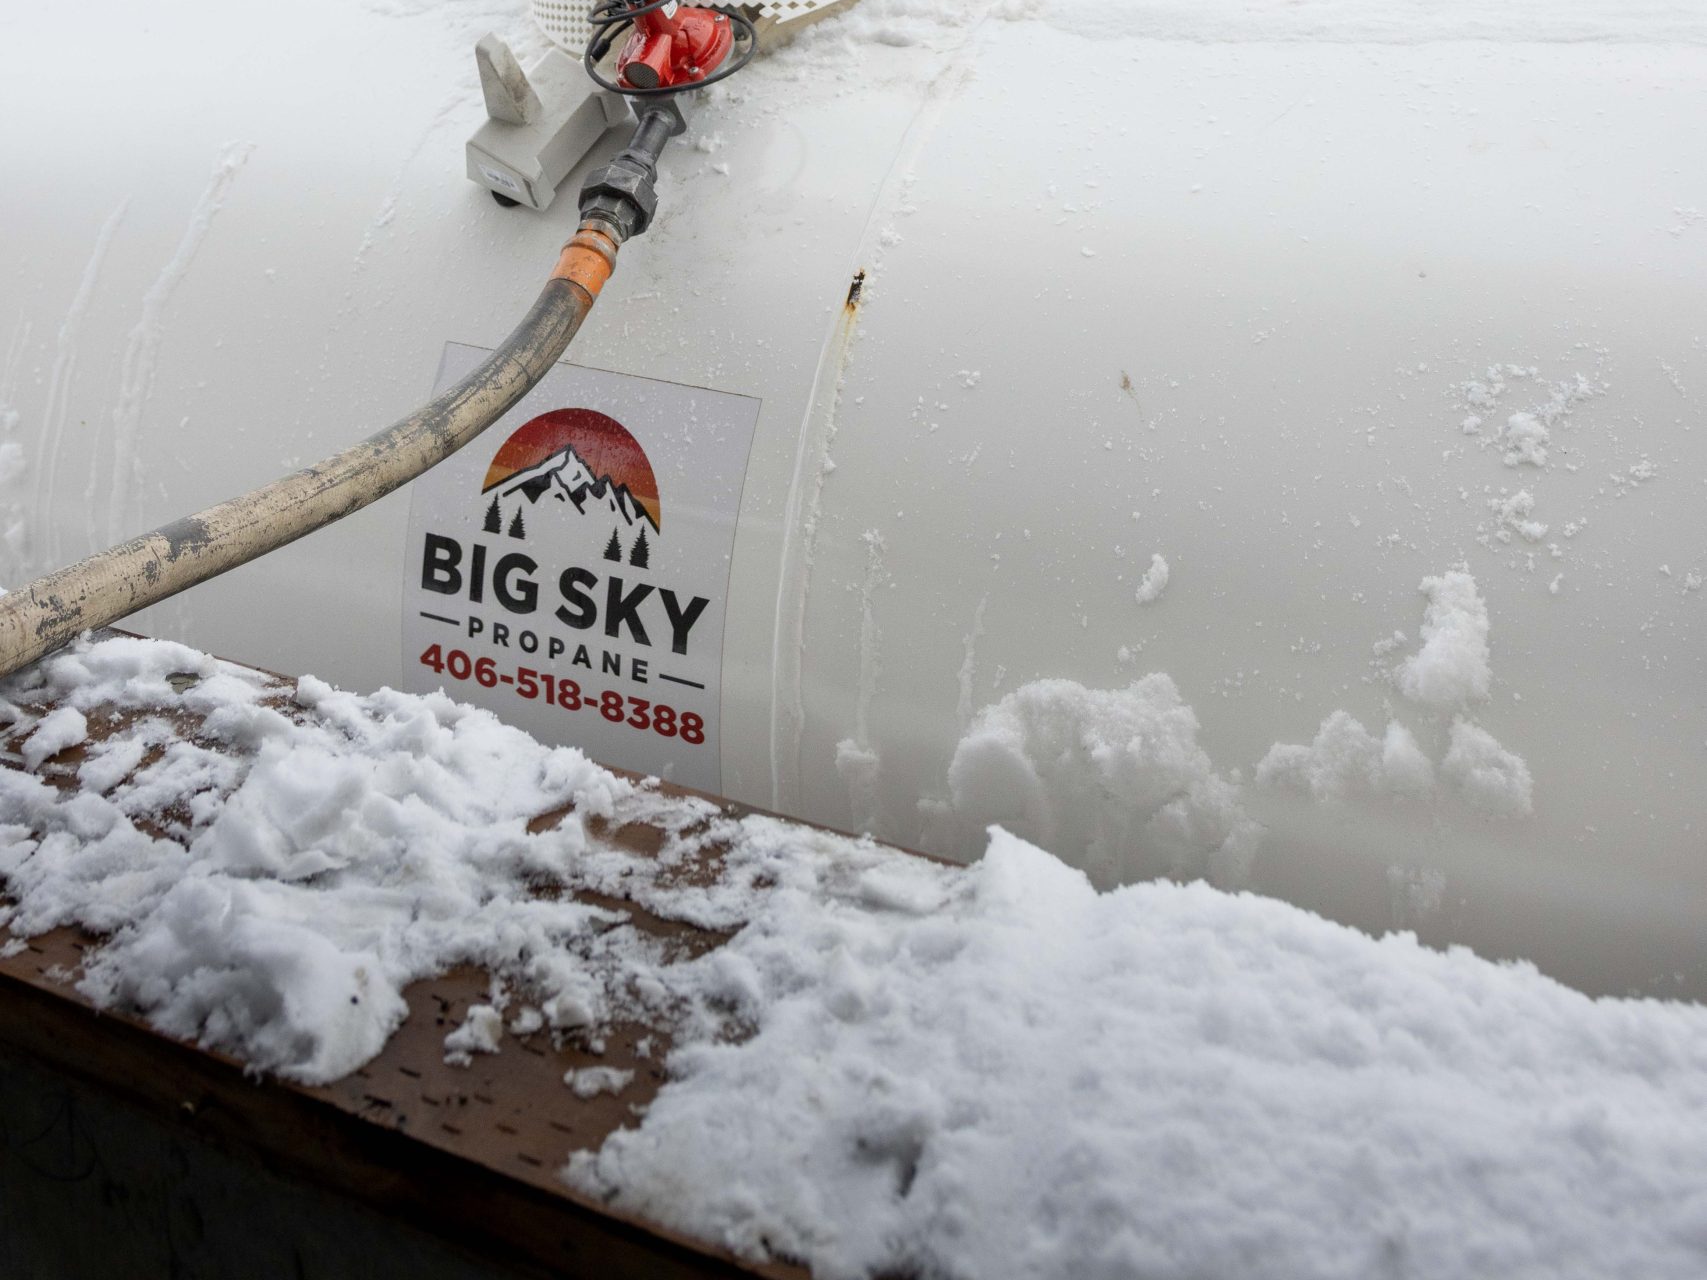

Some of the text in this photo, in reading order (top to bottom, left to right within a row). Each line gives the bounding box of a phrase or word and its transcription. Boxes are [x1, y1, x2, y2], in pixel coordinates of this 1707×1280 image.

[421, 533, 710, 655] BIG SKY
[420, 644, 705, 745] 406-518-8388
[468, 617, 649, 683] PROPANE
